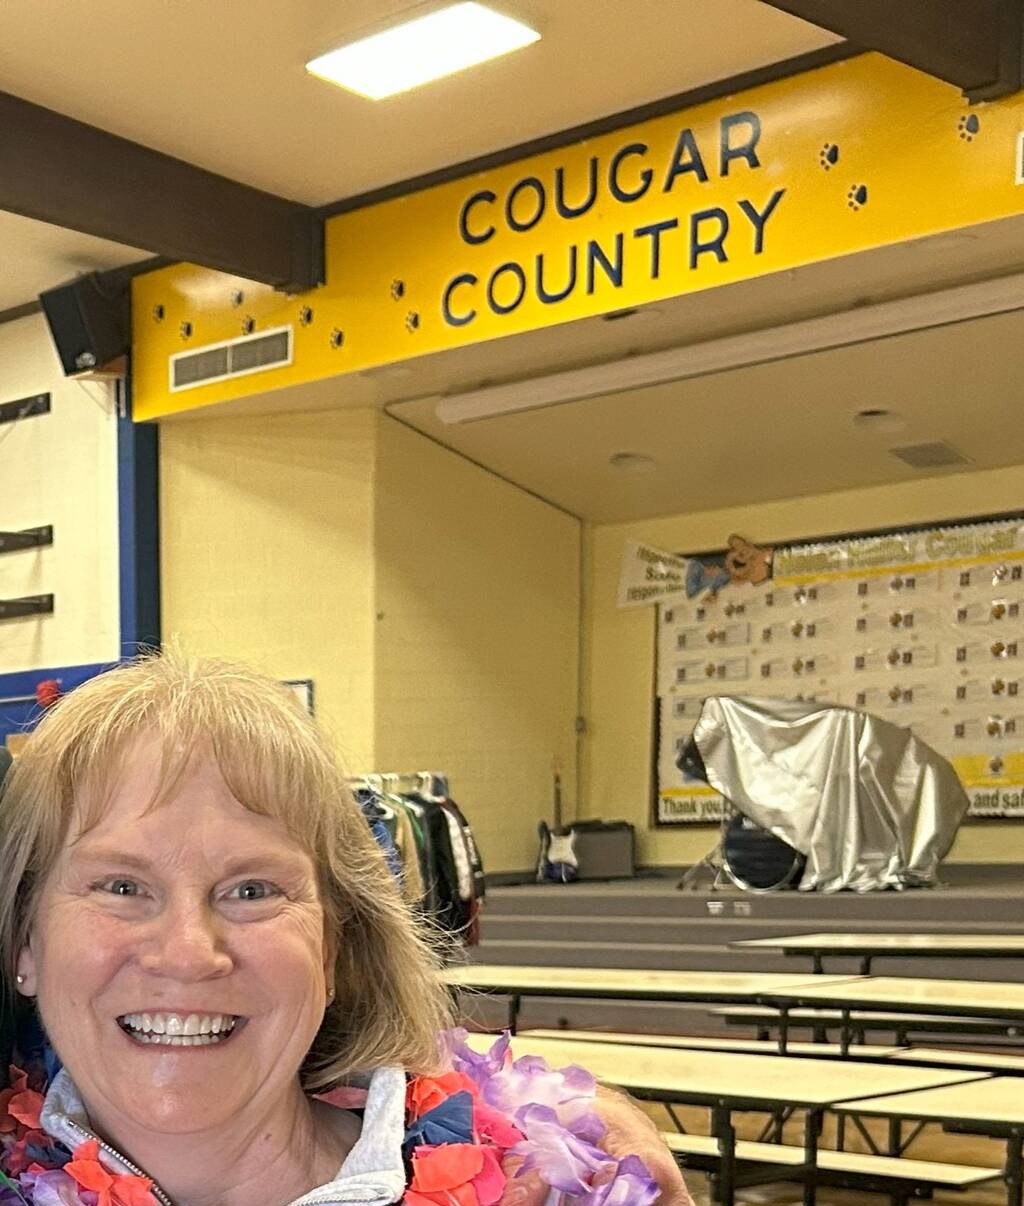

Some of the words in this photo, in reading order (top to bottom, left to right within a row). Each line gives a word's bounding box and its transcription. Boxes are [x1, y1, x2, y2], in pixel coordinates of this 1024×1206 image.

[459, 111, 762, 246] COUGAR
[442, 188, 787, 327] COUNTRY
[974, 789, 999, 809] and
